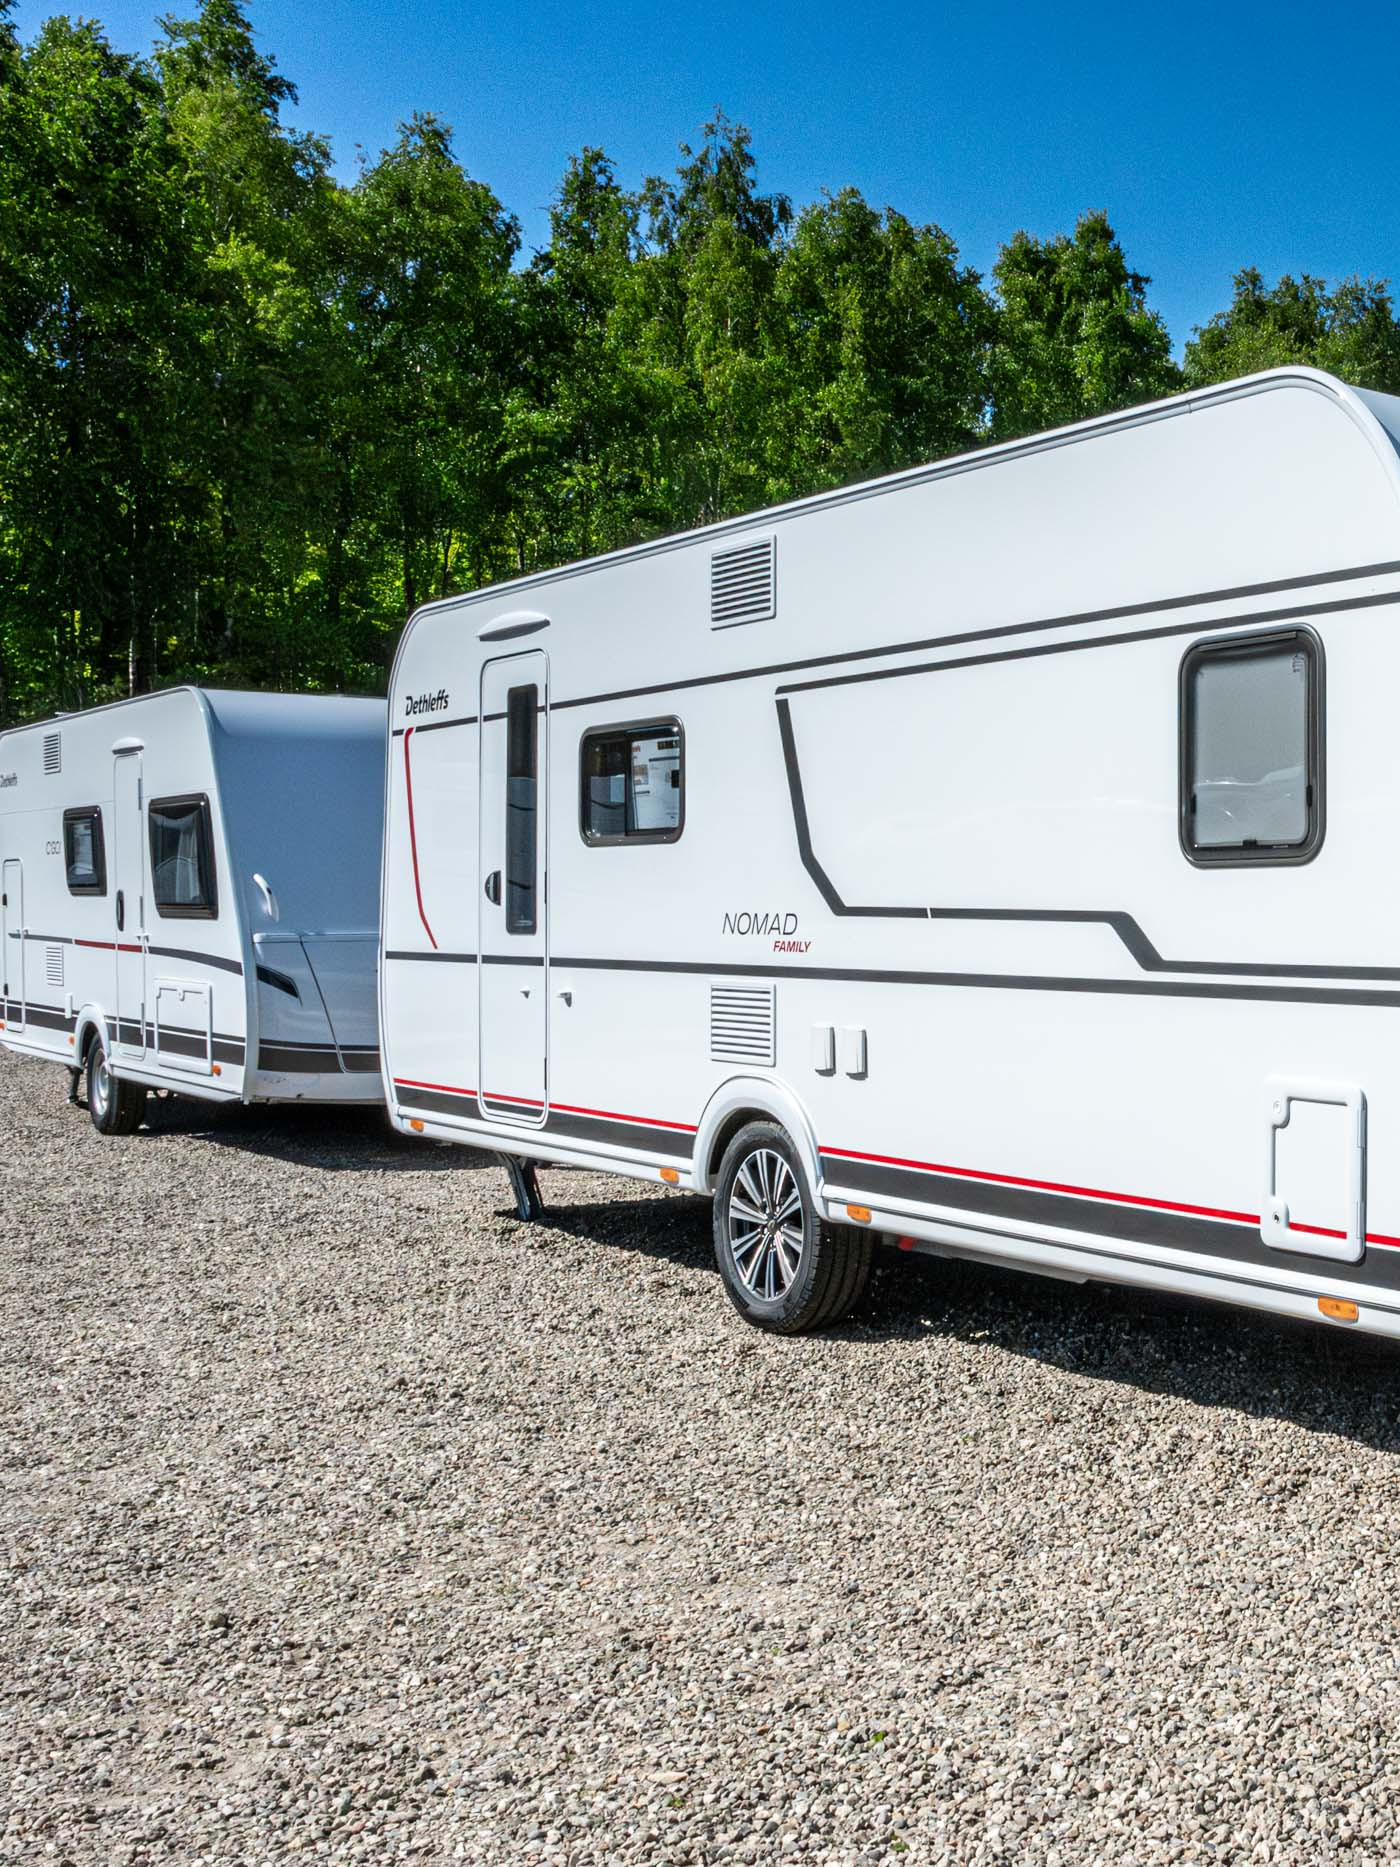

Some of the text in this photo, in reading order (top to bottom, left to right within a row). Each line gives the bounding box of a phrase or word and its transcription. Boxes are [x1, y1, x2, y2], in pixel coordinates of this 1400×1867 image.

[405, 688, 449, 716] Dethleffs
[722, 912, 798, 936] NOMAD
[773, 940, 811, 953] FAMILY
